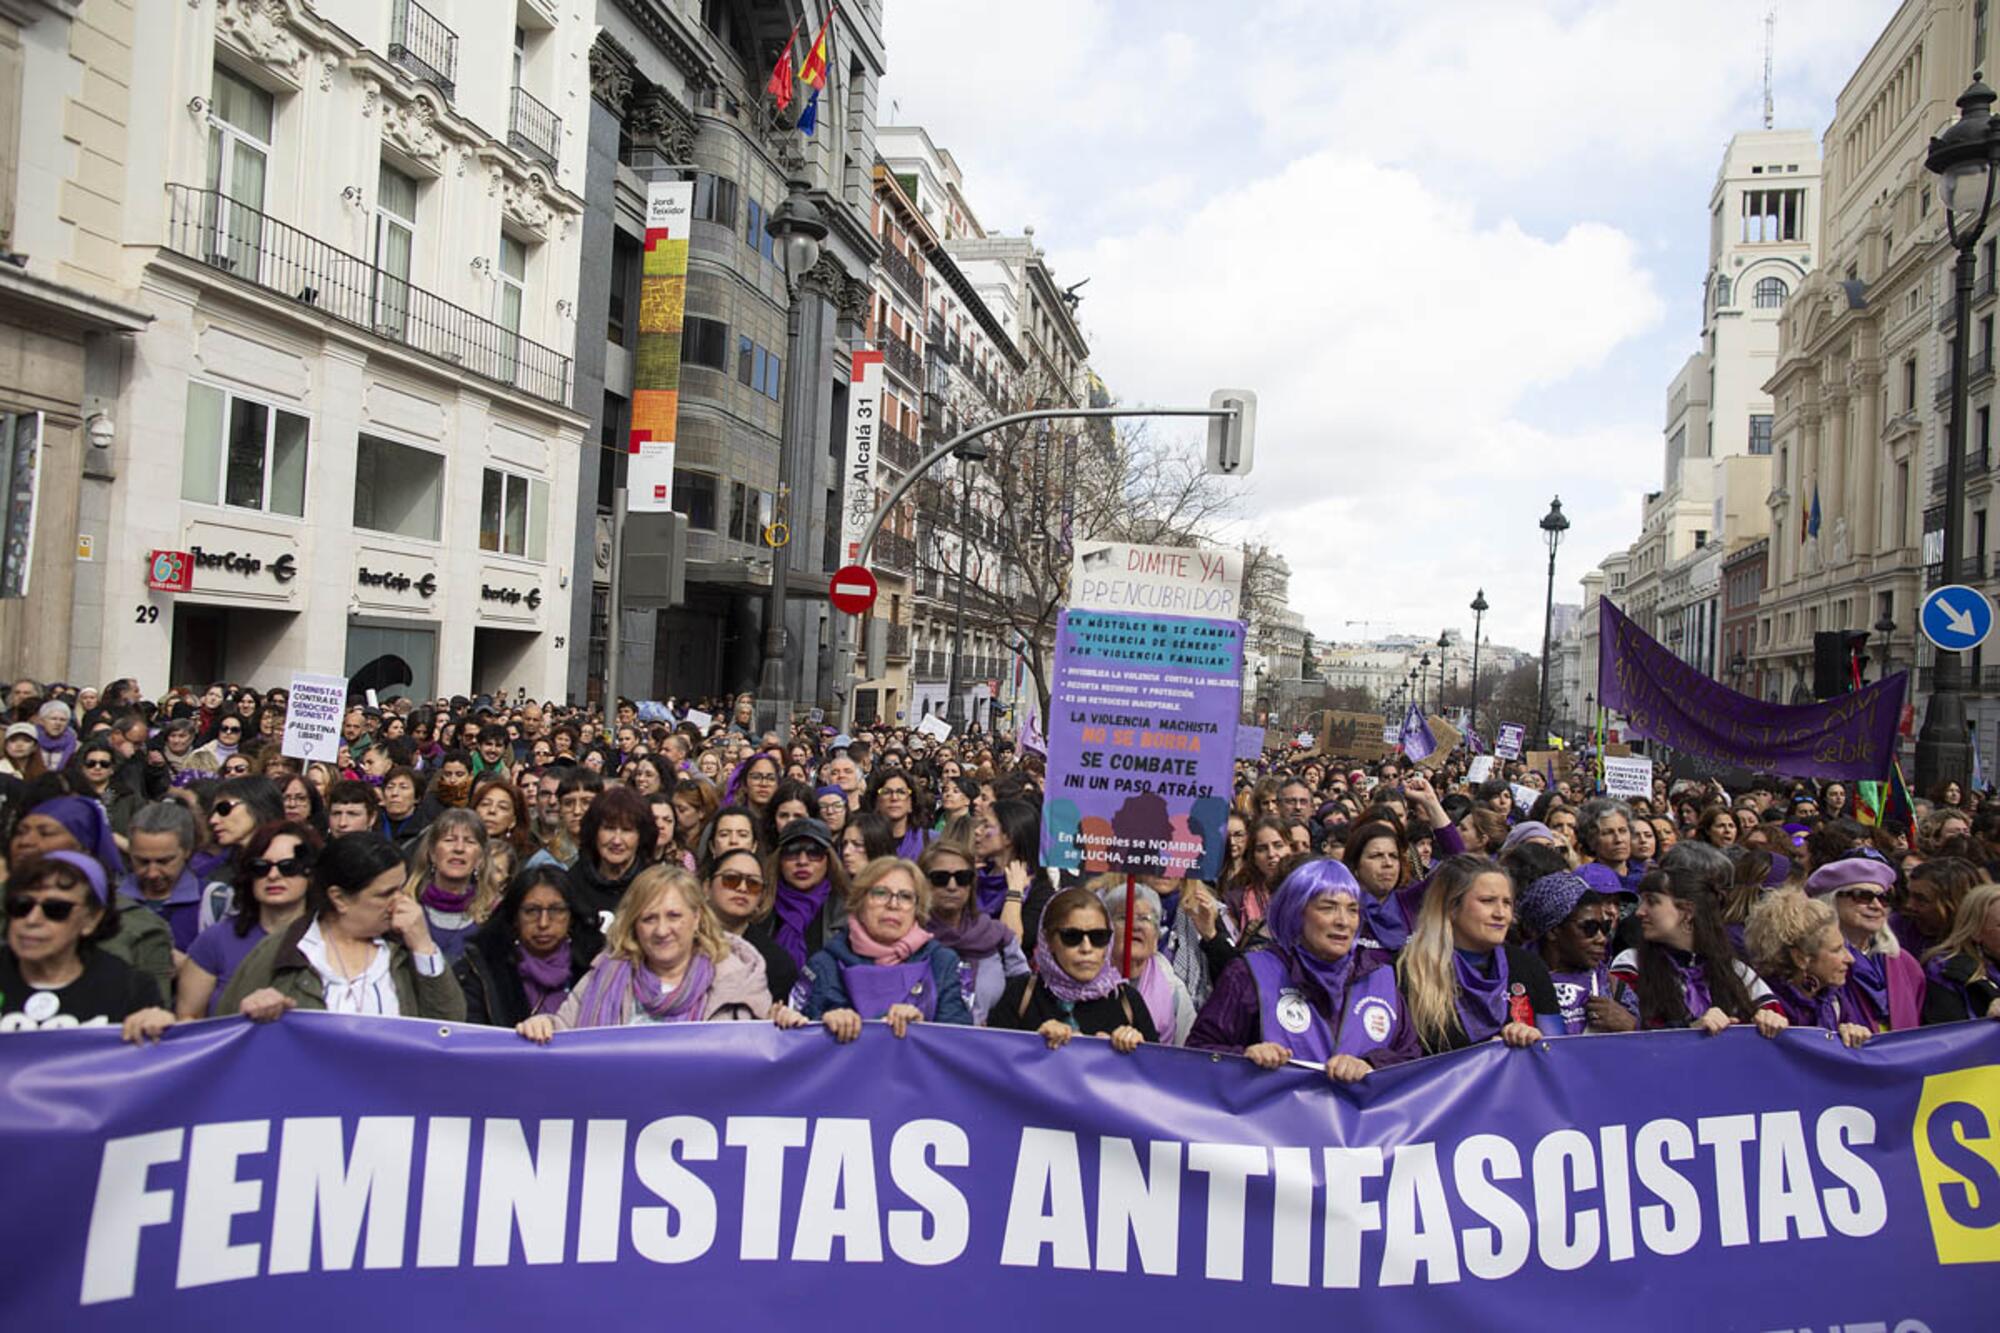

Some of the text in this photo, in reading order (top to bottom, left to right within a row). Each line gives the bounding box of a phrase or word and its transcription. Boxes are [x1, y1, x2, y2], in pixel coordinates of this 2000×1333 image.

[850, 399, 873, 526] Sala Alcalá 31
[1127, 549, 1226, 582] DIMITE YA
[136, 605, 159, 624] 29
[1068, 616, 1236, 639] EN MÓSTOLES NO SE CAMBIA
[555, 637, 565, 648] 29
[1069, 646, 1091, 656] POR
[1152, 638, 1165, 648] DE
[293, 684, 343, 697] FEMINISTAS
[293, 692, 340, 706] CONTRA EL
[292, 701, 340, 714] GENOCIDIO
[1070, 712, 1218, 734] LA VIOLENCIA MACHISTA
[1082, 726, 1200, 752] NO SE BORRA
[1080, 752, 1198, 776] SE COMBATE
[1089, 777, 1109, 790] UN
[1114, 778, 1152, 794] PASO
[1058, 832, 1207, 855] En Móstoles se NOMBRA,
[1064, 850, 1201, 869] se LUCHA, se PROTEGE.
[1000, 1104, 1887, 1289] ANTIFASCISTAS
[80, 1114, 970, 1306] FEMINISTAS
